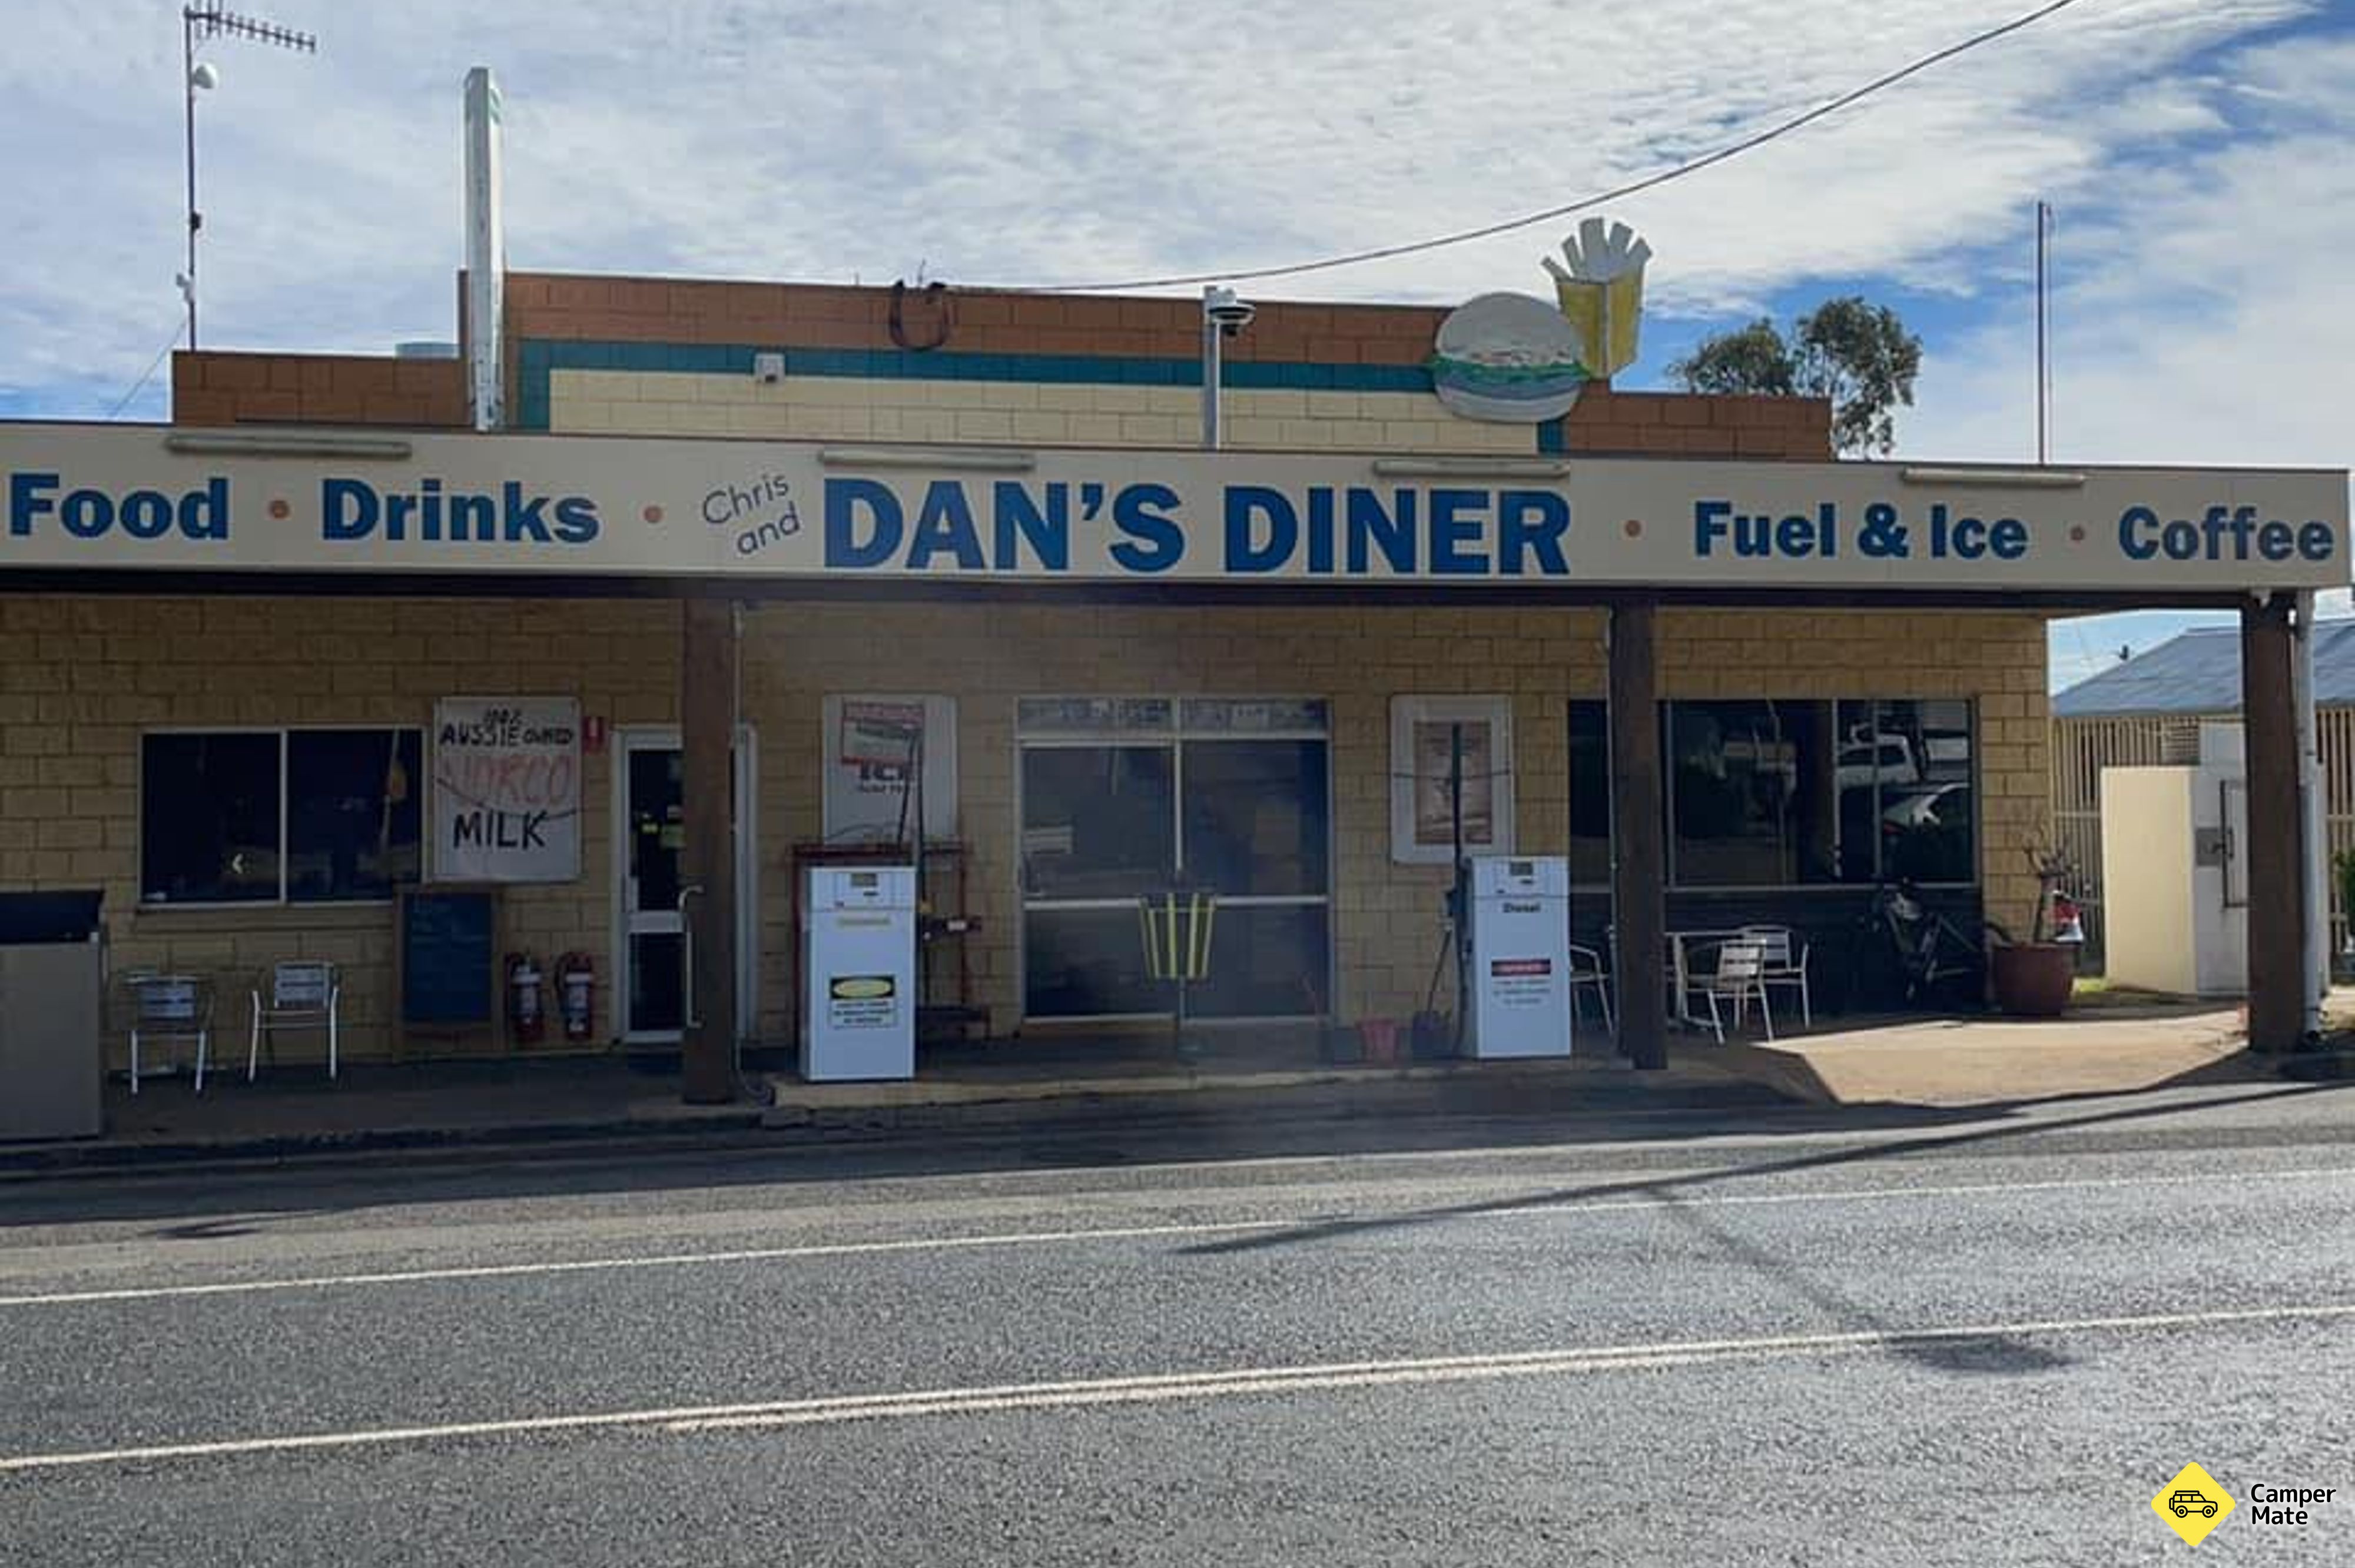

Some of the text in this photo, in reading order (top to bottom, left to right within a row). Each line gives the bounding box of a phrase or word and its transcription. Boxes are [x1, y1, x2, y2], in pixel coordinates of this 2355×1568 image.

[9, 473, 229, 540] Food
[321, 478, 600, 544] Drinks
[702, 472, 791, 525] Chris
[737, 503, 801, 555] and
[824, 477, 1571, 575] DAN'S DINER
[1694, 501, 2029, 559] Fuel & Ice
[2118, 507, 2334, 560] Coffee
[439, 722, 520, 748] AUSSIE
[453, 809, 548, 849] MILK
